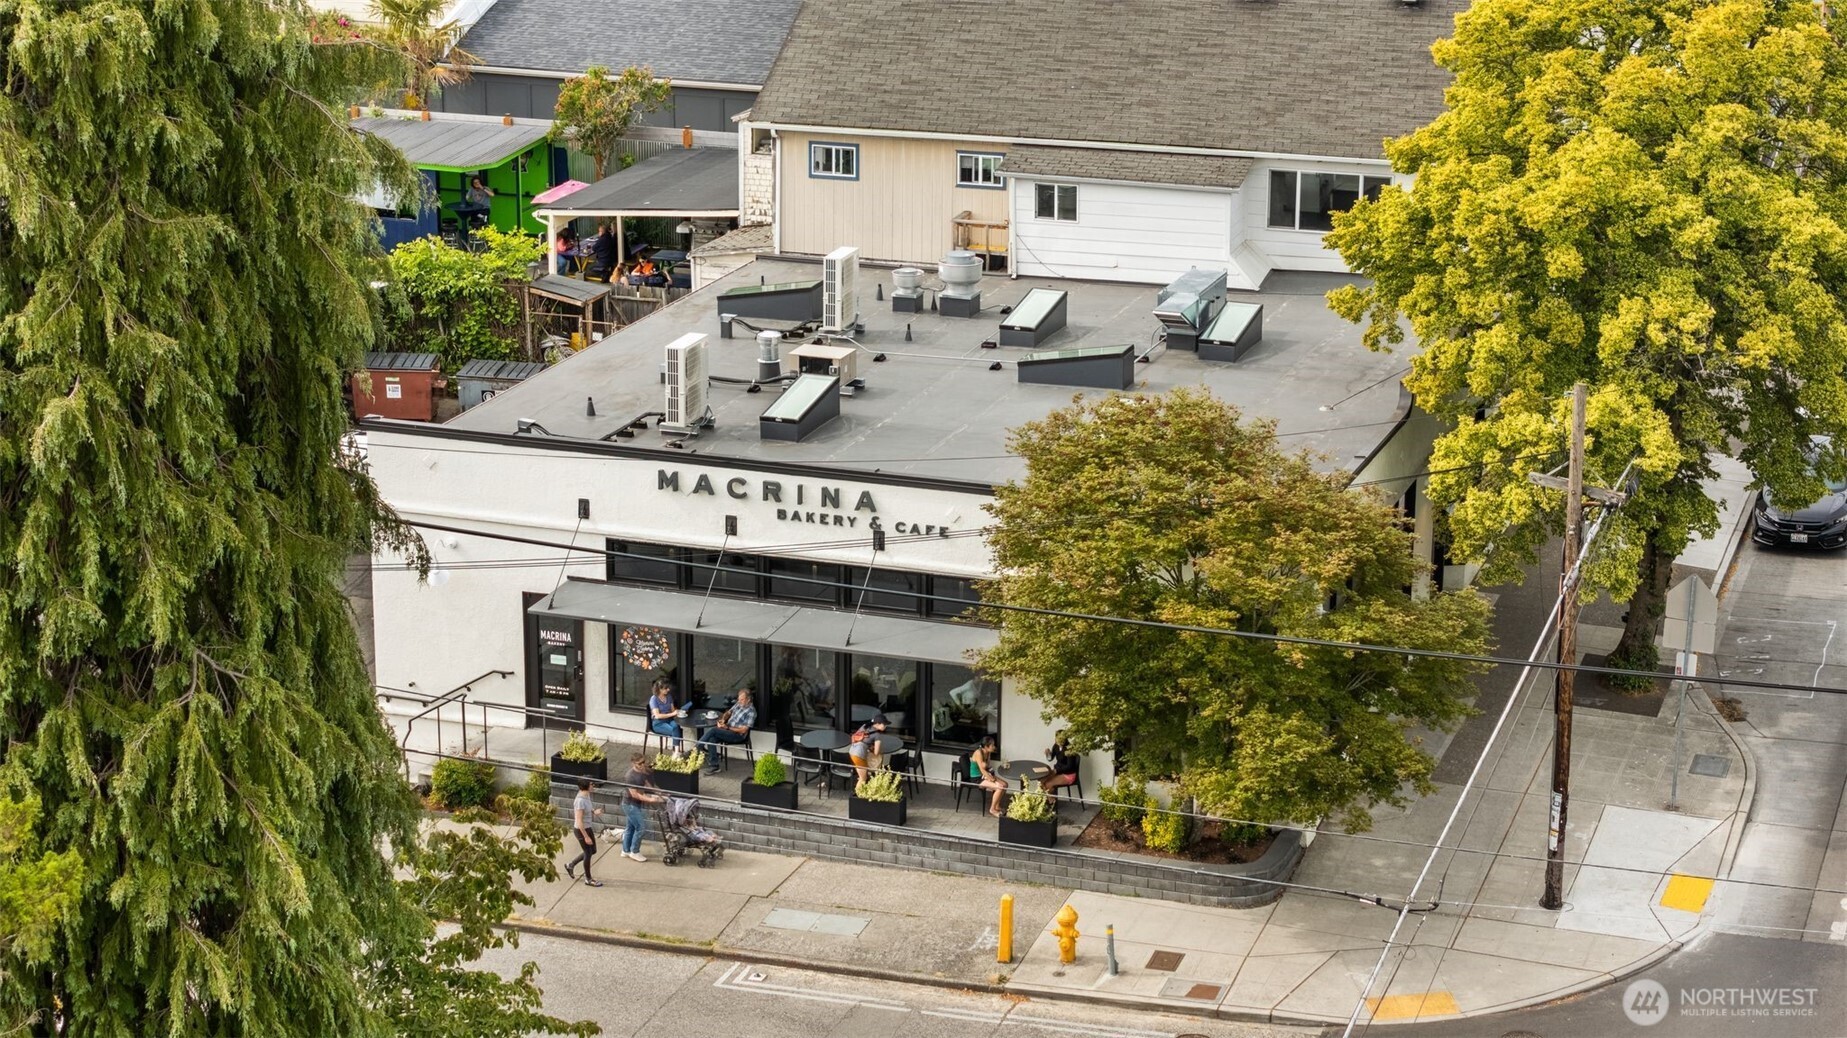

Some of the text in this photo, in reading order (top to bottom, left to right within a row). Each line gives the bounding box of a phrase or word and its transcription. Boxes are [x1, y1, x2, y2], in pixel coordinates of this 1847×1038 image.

[658, 469, 877, 513] MACRINA
[777, 508, 949, 538] BAKERY & CAFE
[540, 630, 572, 642] MACRINA
